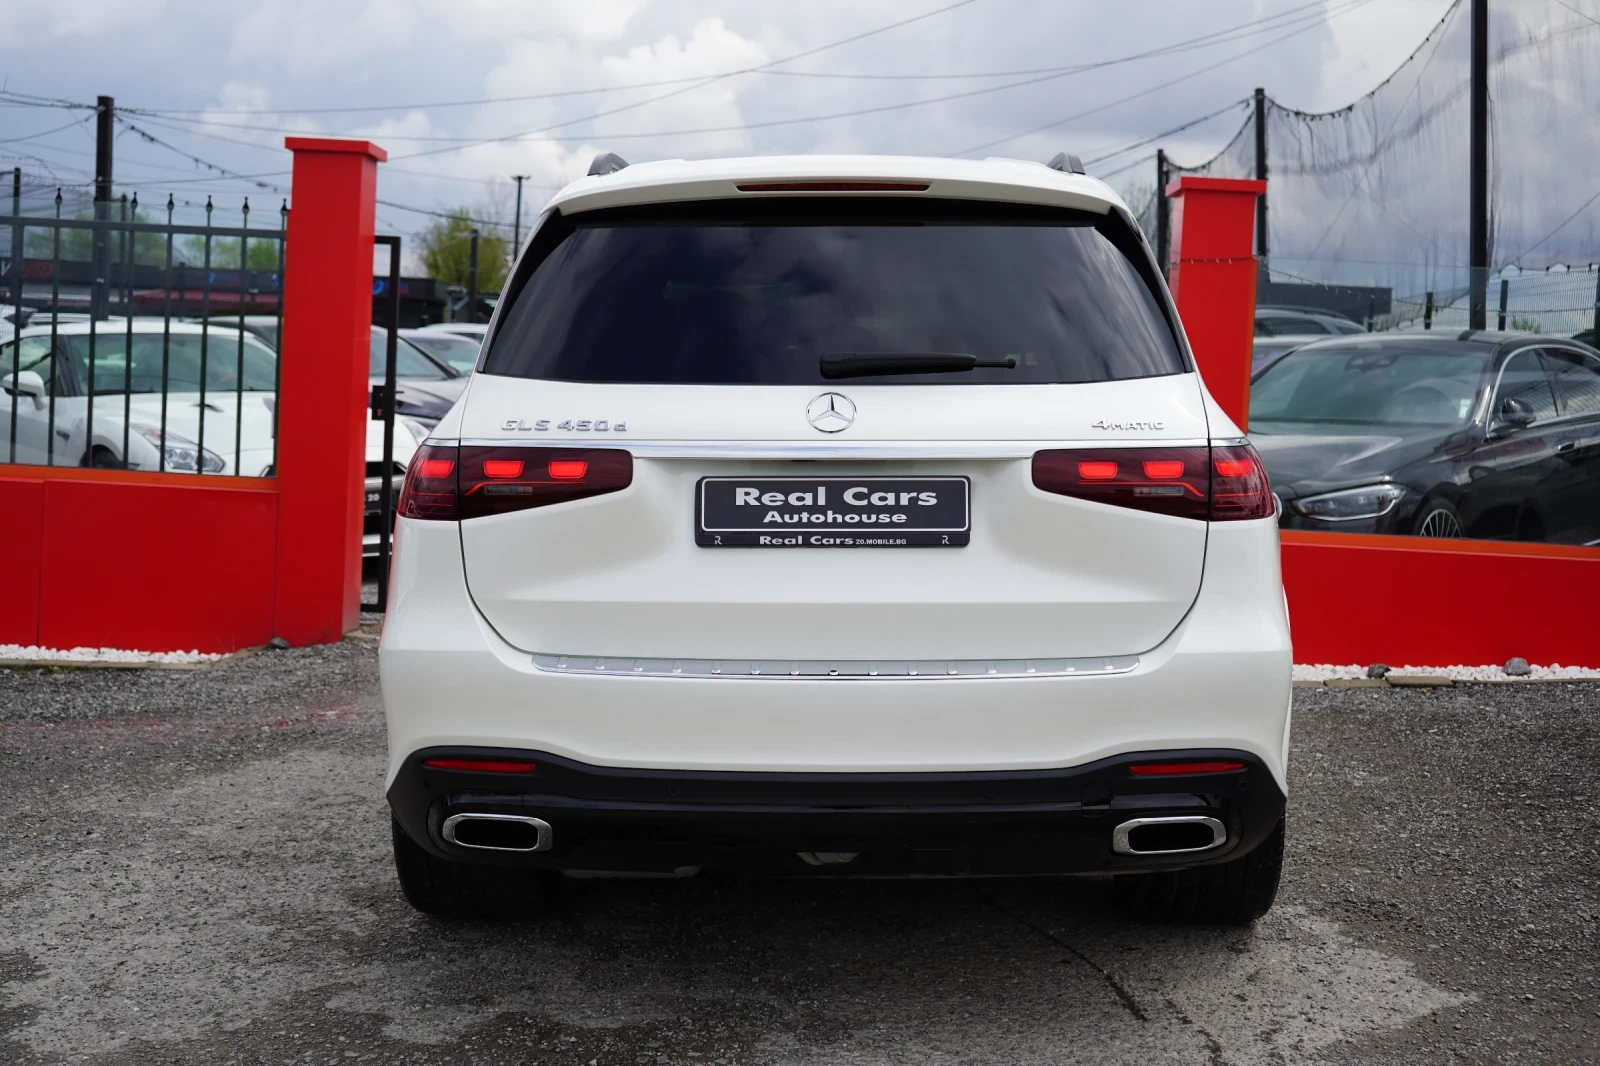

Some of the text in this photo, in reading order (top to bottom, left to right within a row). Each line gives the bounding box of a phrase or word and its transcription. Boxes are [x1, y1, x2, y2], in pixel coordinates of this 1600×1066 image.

[501, 419, 550, 431] GLS
[557, 419, 610, 431] 450
[1091, 418, 1164, 431] 4MATIC
[735, 486, 938, 506] Real Cars
[762, 510, 908, 523] Autohouse
[759, 535, 803, 545] Real
[809, 535, 854, 545] Cars
